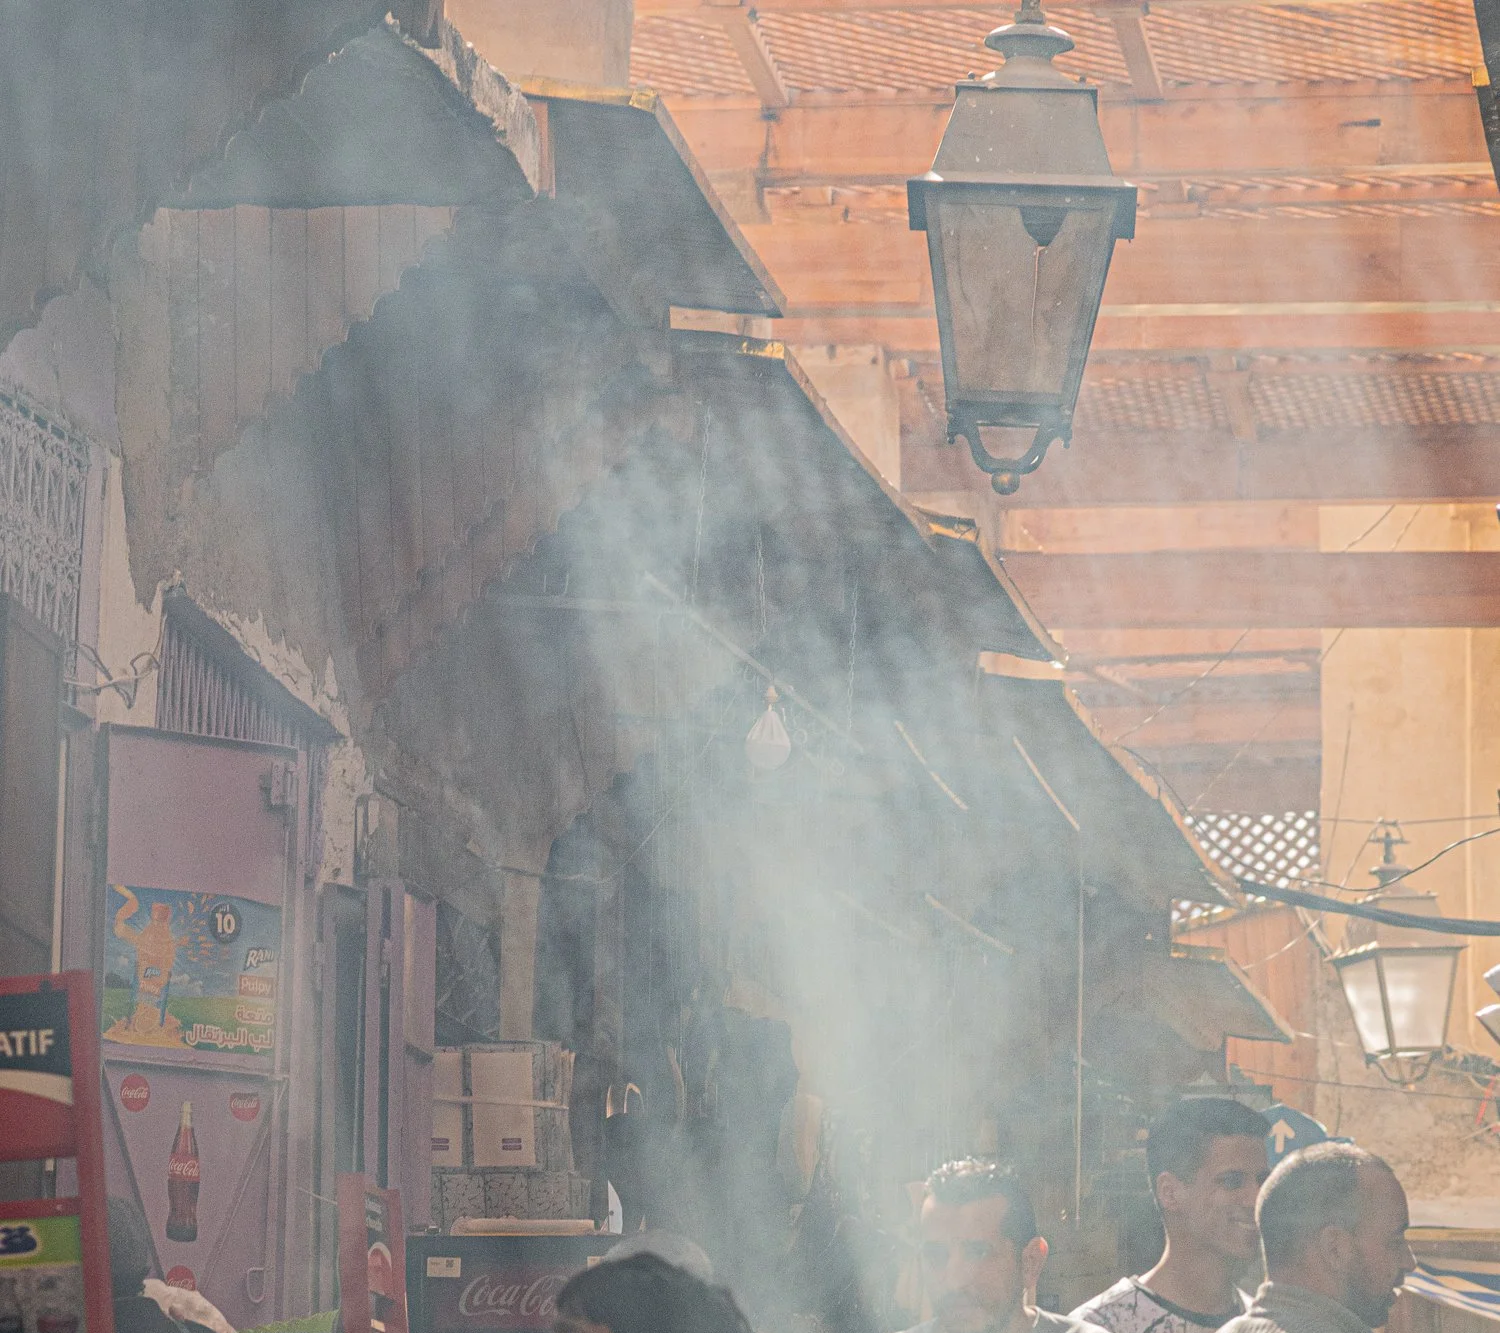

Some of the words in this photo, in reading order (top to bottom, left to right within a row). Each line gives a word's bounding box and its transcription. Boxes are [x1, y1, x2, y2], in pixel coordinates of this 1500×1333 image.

[215, 911, 236, 934] 10
[240, 977, 272, 995] Pulpy
[235, 1005, 274, 1025] متعة
[186, 1024, 248, 1049] البرتقال
[459, 1274, 568, 1317] Coca-Co
